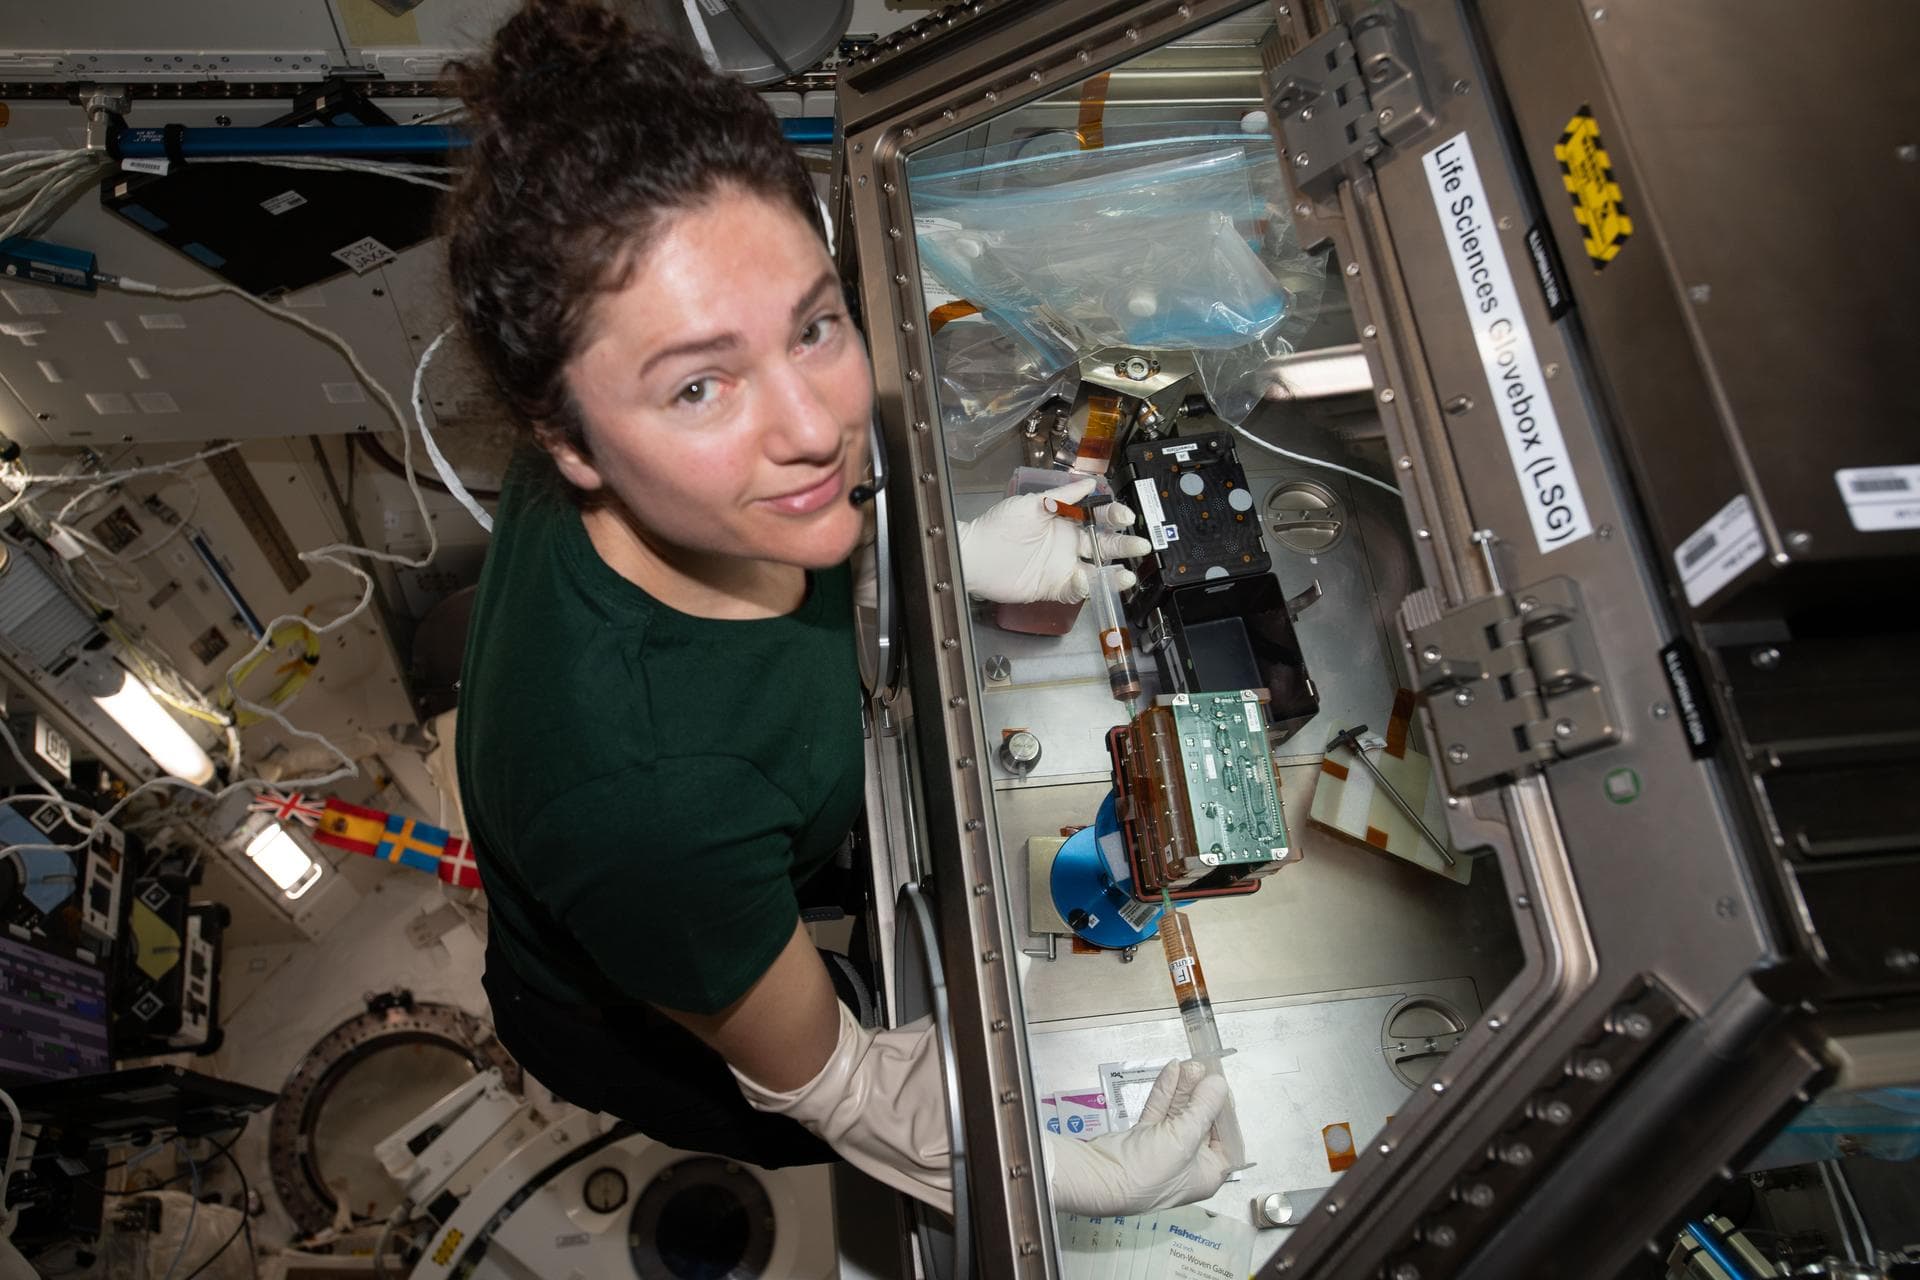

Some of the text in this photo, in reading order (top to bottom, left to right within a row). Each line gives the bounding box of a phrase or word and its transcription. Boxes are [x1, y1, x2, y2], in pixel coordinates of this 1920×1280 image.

[1435, 142, 1576, 542] Life Sciences Glovebox (LSG)
[1169, 1225, 1221, 1250] Fisherbrand
[1169, 1248, 1212, 1270] Non-Woven
[1212, 1264, 1234, 1279] Gauze
